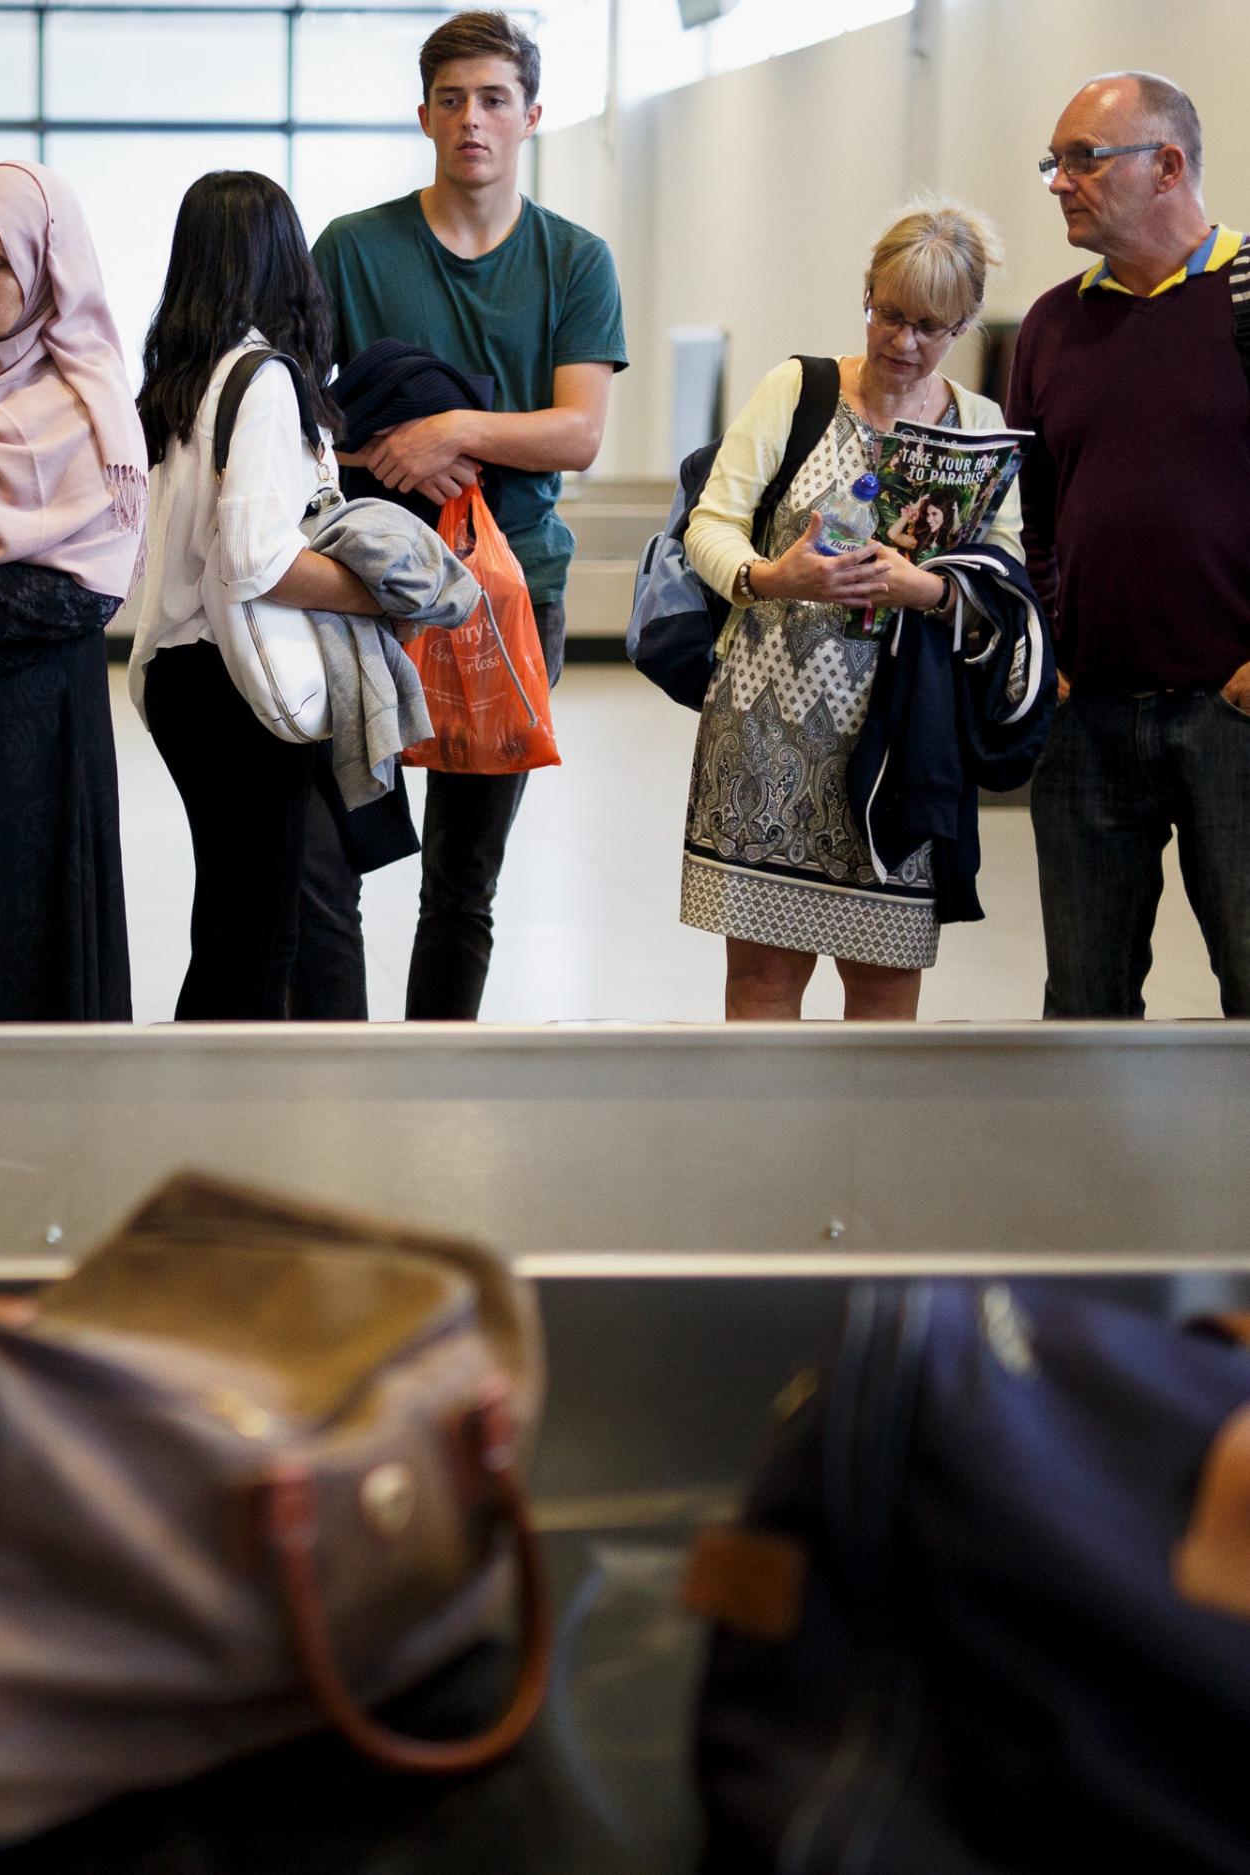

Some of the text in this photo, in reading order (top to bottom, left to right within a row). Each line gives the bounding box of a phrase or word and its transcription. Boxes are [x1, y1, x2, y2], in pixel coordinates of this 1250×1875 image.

[901, 448, 999, 471] TAKE YOUR HAIR
[909, 465, 986, 485] TO PARADISE
